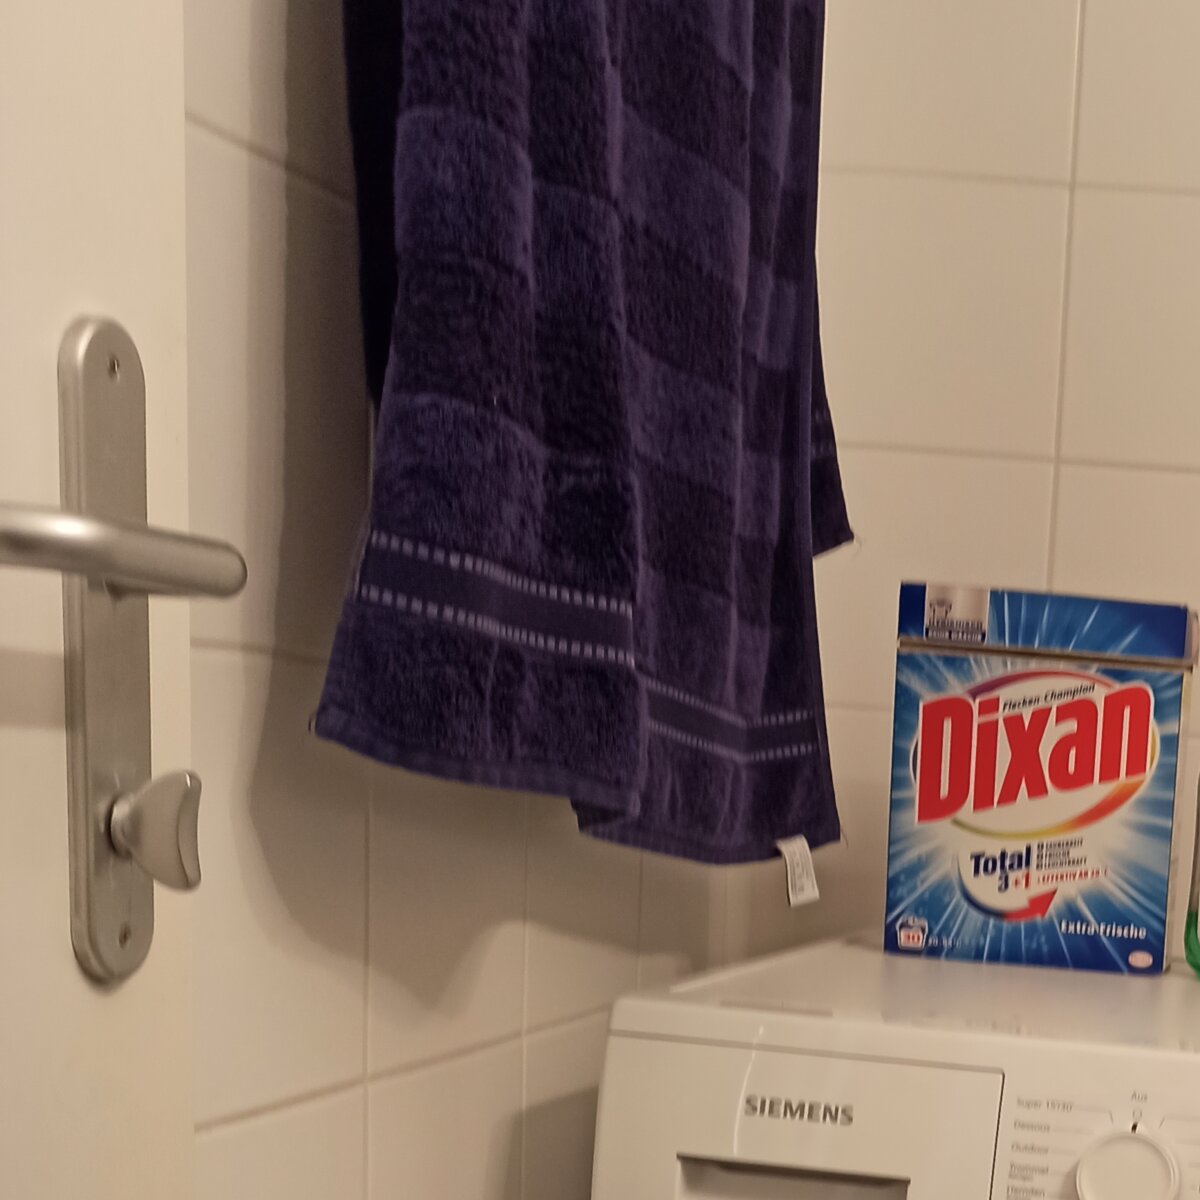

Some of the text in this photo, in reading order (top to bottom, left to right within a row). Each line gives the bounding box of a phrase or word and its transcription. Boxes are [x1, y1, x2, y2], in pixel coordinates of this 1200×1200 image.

[1044, 682, 1095, 702] Champion
[916, 685, 1152, 823] Dixan
[970, 844, 1032, 877] Total
[1061, 920, 1095, 935] Extra
[1131, 1091, 1147, 1102] Aus
[745, 1095, 854, 1127] SIEMENS
